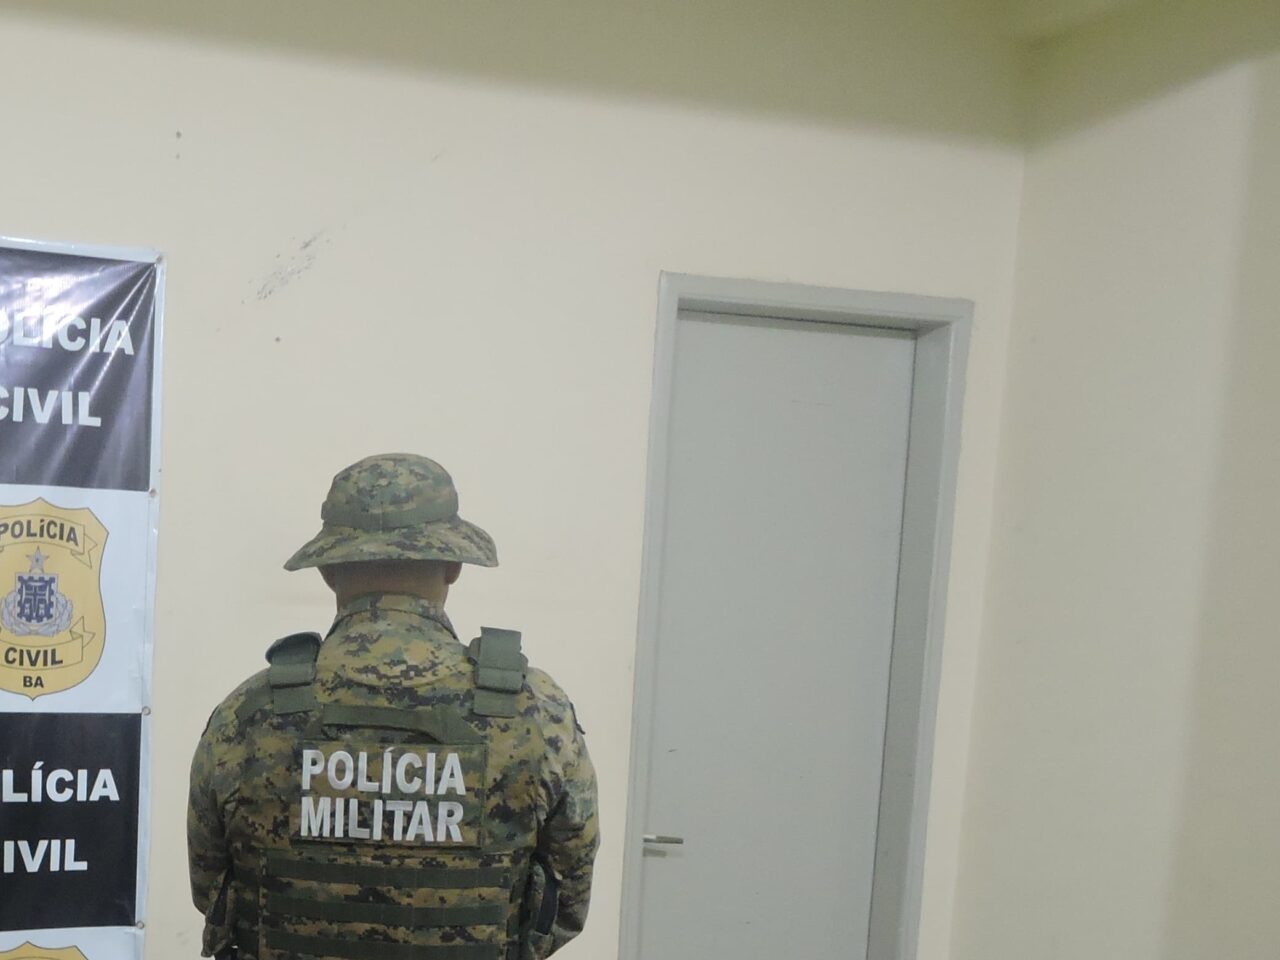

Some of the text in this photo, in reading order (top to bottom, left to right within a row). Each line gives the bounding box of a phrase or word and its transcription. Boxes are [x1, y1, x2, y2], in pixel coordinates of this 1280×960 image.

[5, 647, 63, 666] CIVIL
[23, 676, 44, 688] BA
[302, 747, 466, 795] POLÍCIA
[301, 796, 463, 842] MILITAR
